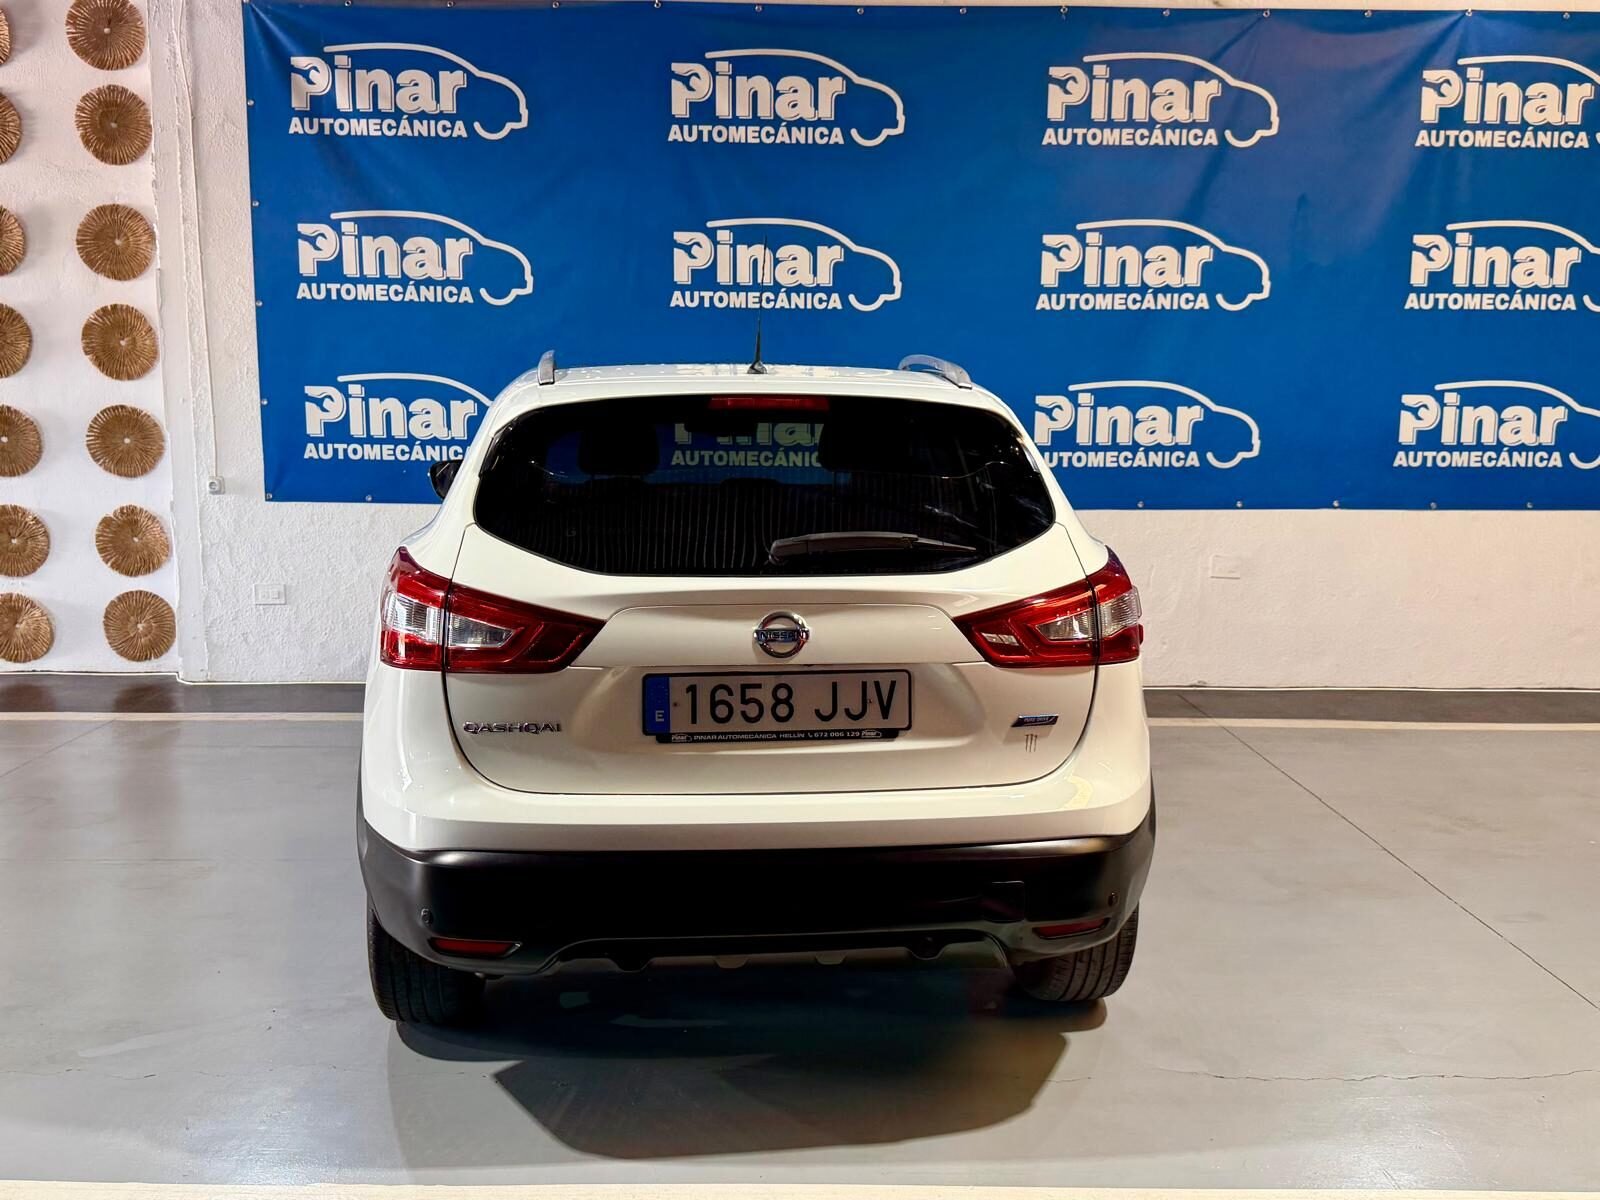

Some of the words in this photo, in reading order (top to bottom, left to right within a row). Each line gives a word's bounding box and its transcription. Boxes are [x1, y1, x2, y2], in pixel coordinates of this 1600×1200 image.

[290, 55, 467, 113] Pinar
[671, 61, 846, 121] Pinar
[1046, 65, 1221, 124] Pinar
[1419, 66, 1594, 126] Pinar
[288, 114, 468, 138] AUTOMECÁNICA
[667, 121, 845, 145] AUTOMECÁNICA
[1041, 124, 1218, 147] AUTOMECÁNICA
[1414, 126, 1590, 149] AUTOMECÁNICA
[297, 221, 473, 281] Pinar
[673, 229, 844, 288] Pinar
[1040, 231, 1213, 288] Pinar
[1409, 232, 1581, 288] Pinar
[296, 281, 474, 304] AUTOMECÁNICA
[669, 287, 842, 310] AUTOMECÁNICA
[1035, 289, 1209, 311] AUTOMECÁNICA
[1404, 289, 1577, 311] AUTOMECÁNICA
[304, 384, 478, 440] Pinar
[1034, 392, 1204, 446] Pinar
[1400, 392, 1567, 446] Pinar
[303, 441, 470, 461] AUTOMECÁNIC
[671, 448, 821, 468] AUTOMECÁNIC
[1044, 447, 1200, 468] UTOMECÁNICA
[1393, 446, 1563, 468] AUTOMECÁNICA
[685, 683, 794, 724] 1658
[814, 680, 897, 721] JJV
[463, 721, 562, 734] QASHQAI
[655, 710, 665, 722] E
